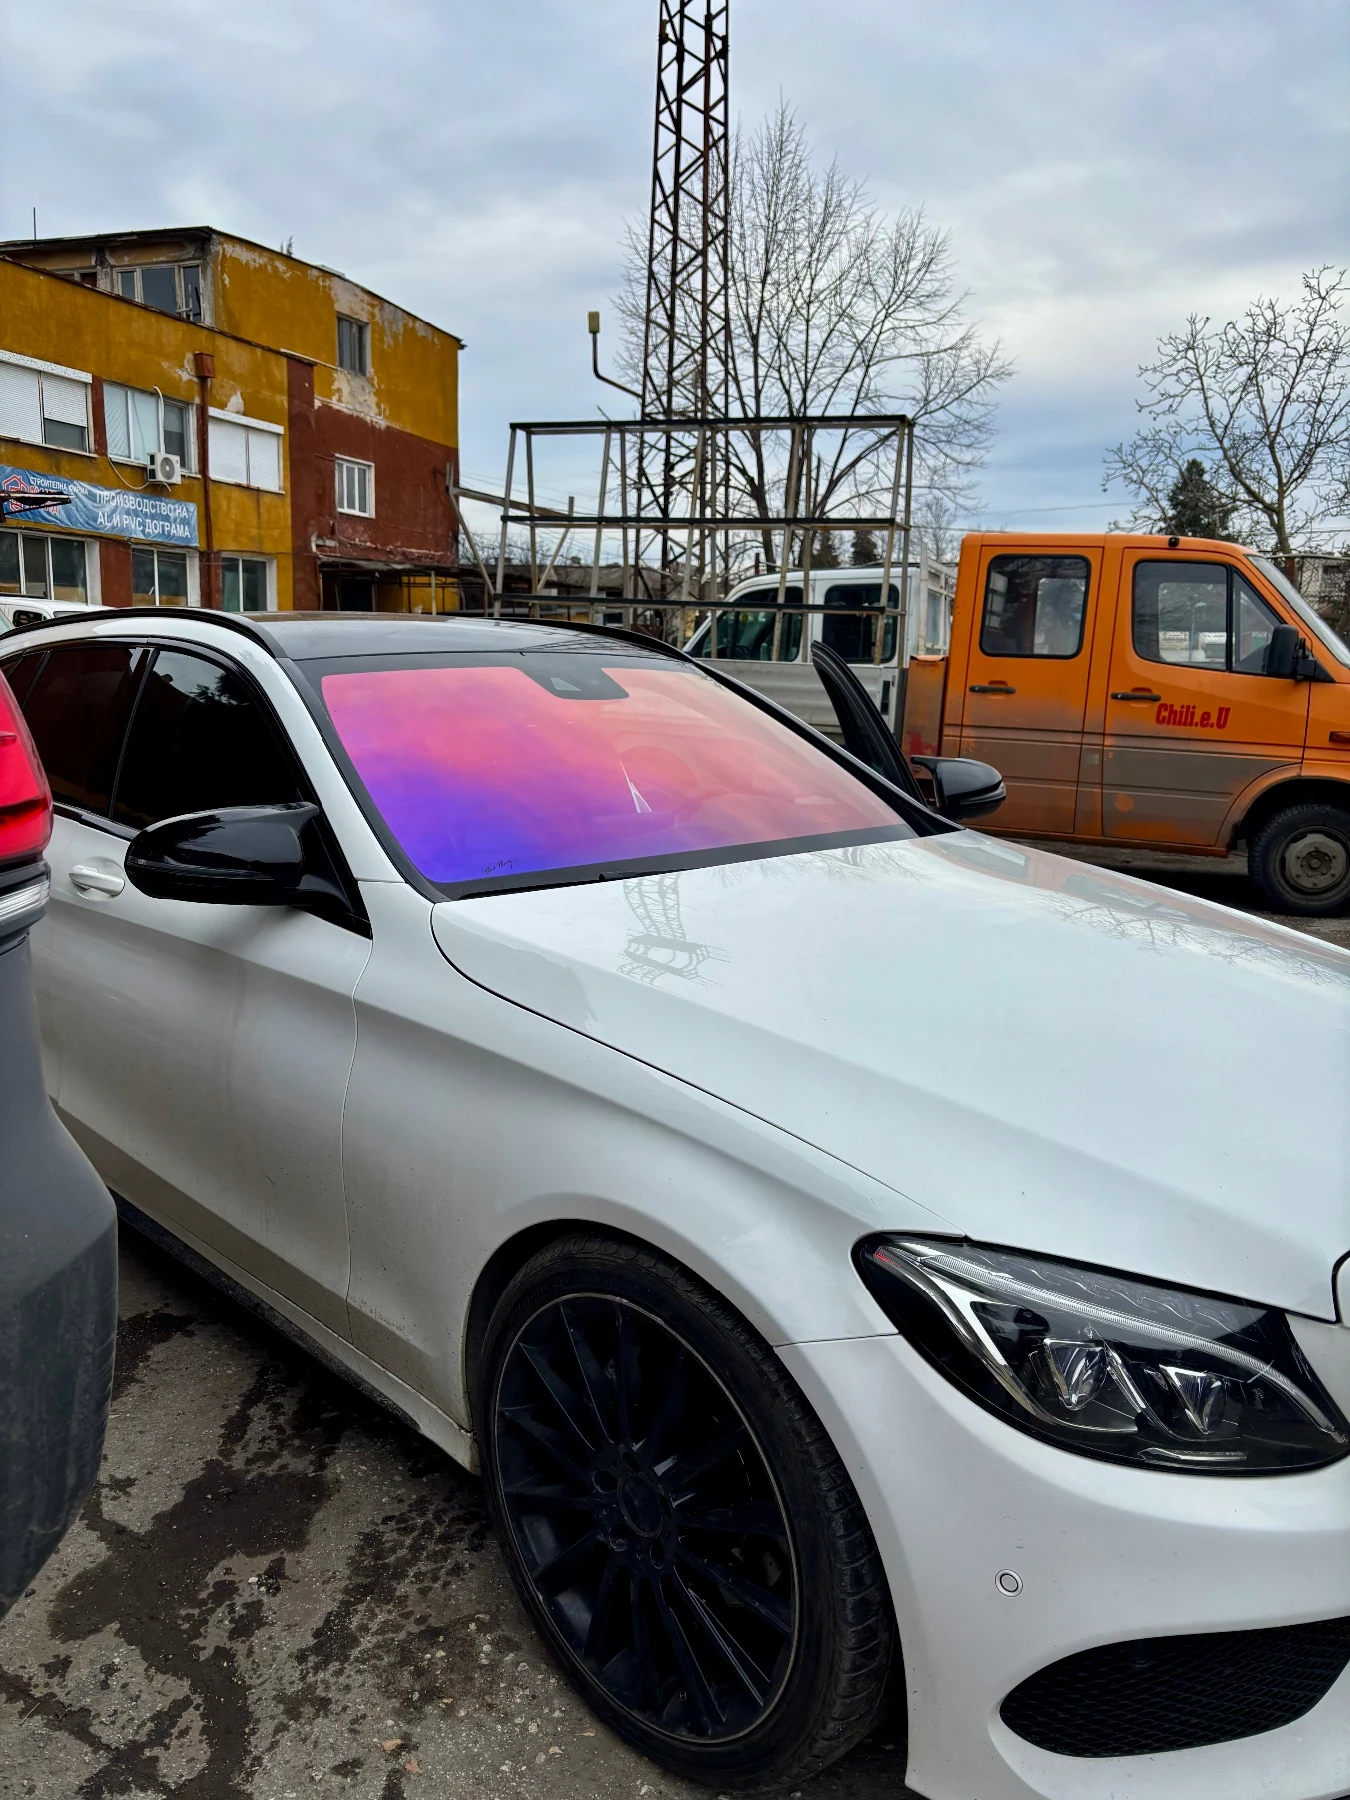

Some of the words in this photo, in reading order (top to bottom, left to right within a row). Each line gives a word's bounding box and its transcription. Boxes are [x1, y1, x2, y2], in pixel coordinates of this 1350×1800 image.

[96, 491, 174, 516] ПРОИЗВОДСТВО
[176, 505, 188, 519] НА
[97, 511, 111, 526] AL
[113, 513, 120, 527] И
[123, 515, 143, 531] PVC
[145, 518, 191, 538] ДОГРАМА
[1155, 703, 1231, 729] Chili.e.U
